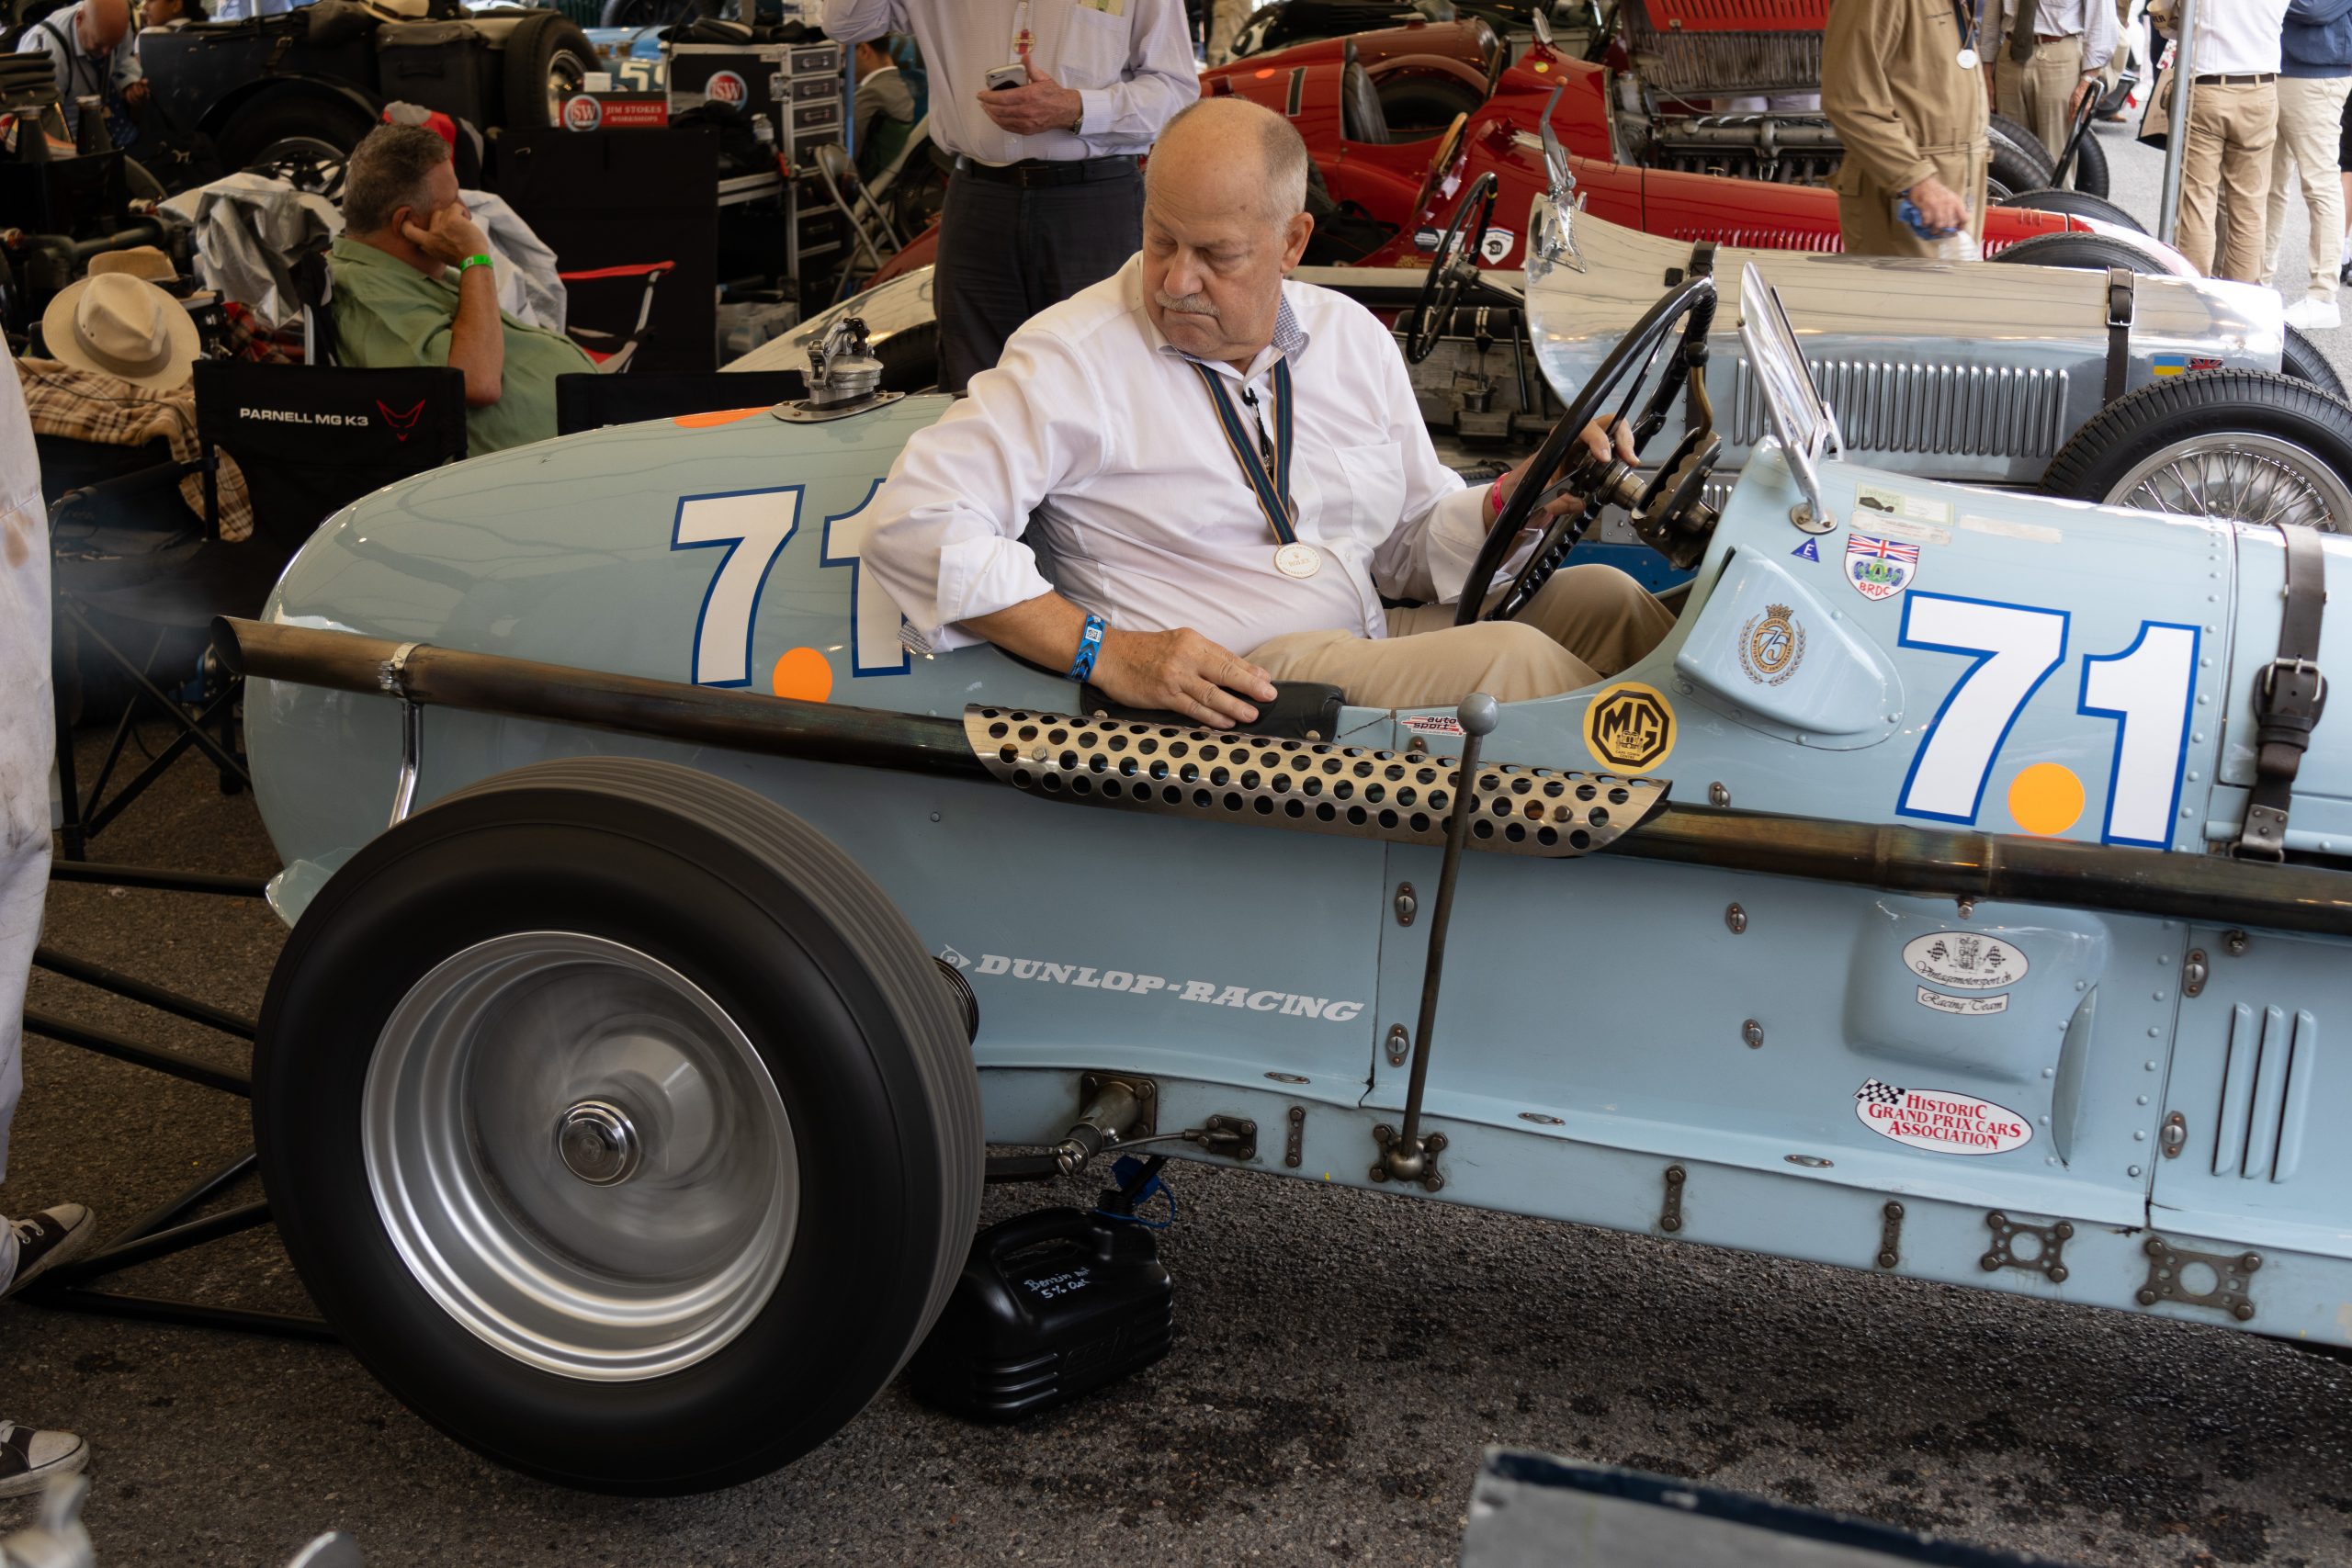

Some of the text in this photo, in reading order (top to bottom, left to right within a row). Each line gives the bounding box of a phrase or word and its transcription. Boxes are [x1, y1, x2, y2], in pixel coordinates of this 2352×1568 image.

[605, 105, 662, 115] JIM STOKES
[240, 407, 368, 427] PARNELL MG K3
[1803, 543, 1815, 557] E
[1859, 581, 1891, 596] BRDC
[1756, 625, 1792, 663] 75
[1413, 722, 1451, 730] sport
[1602, 701, 1659, 753] MG
[1916, 960, 2012, 989] Vintagemotorsport.ch
[974, 953, 1365, 1022] DUNLOP-RACING
[1920, 992, 2003, 1013] Racing Team
[1932, 1112, 1973, 1131] PRIX
[1975, 1120, 2021, 1138] CARS
[1023, 1273, 1073, 1292] Benzin
